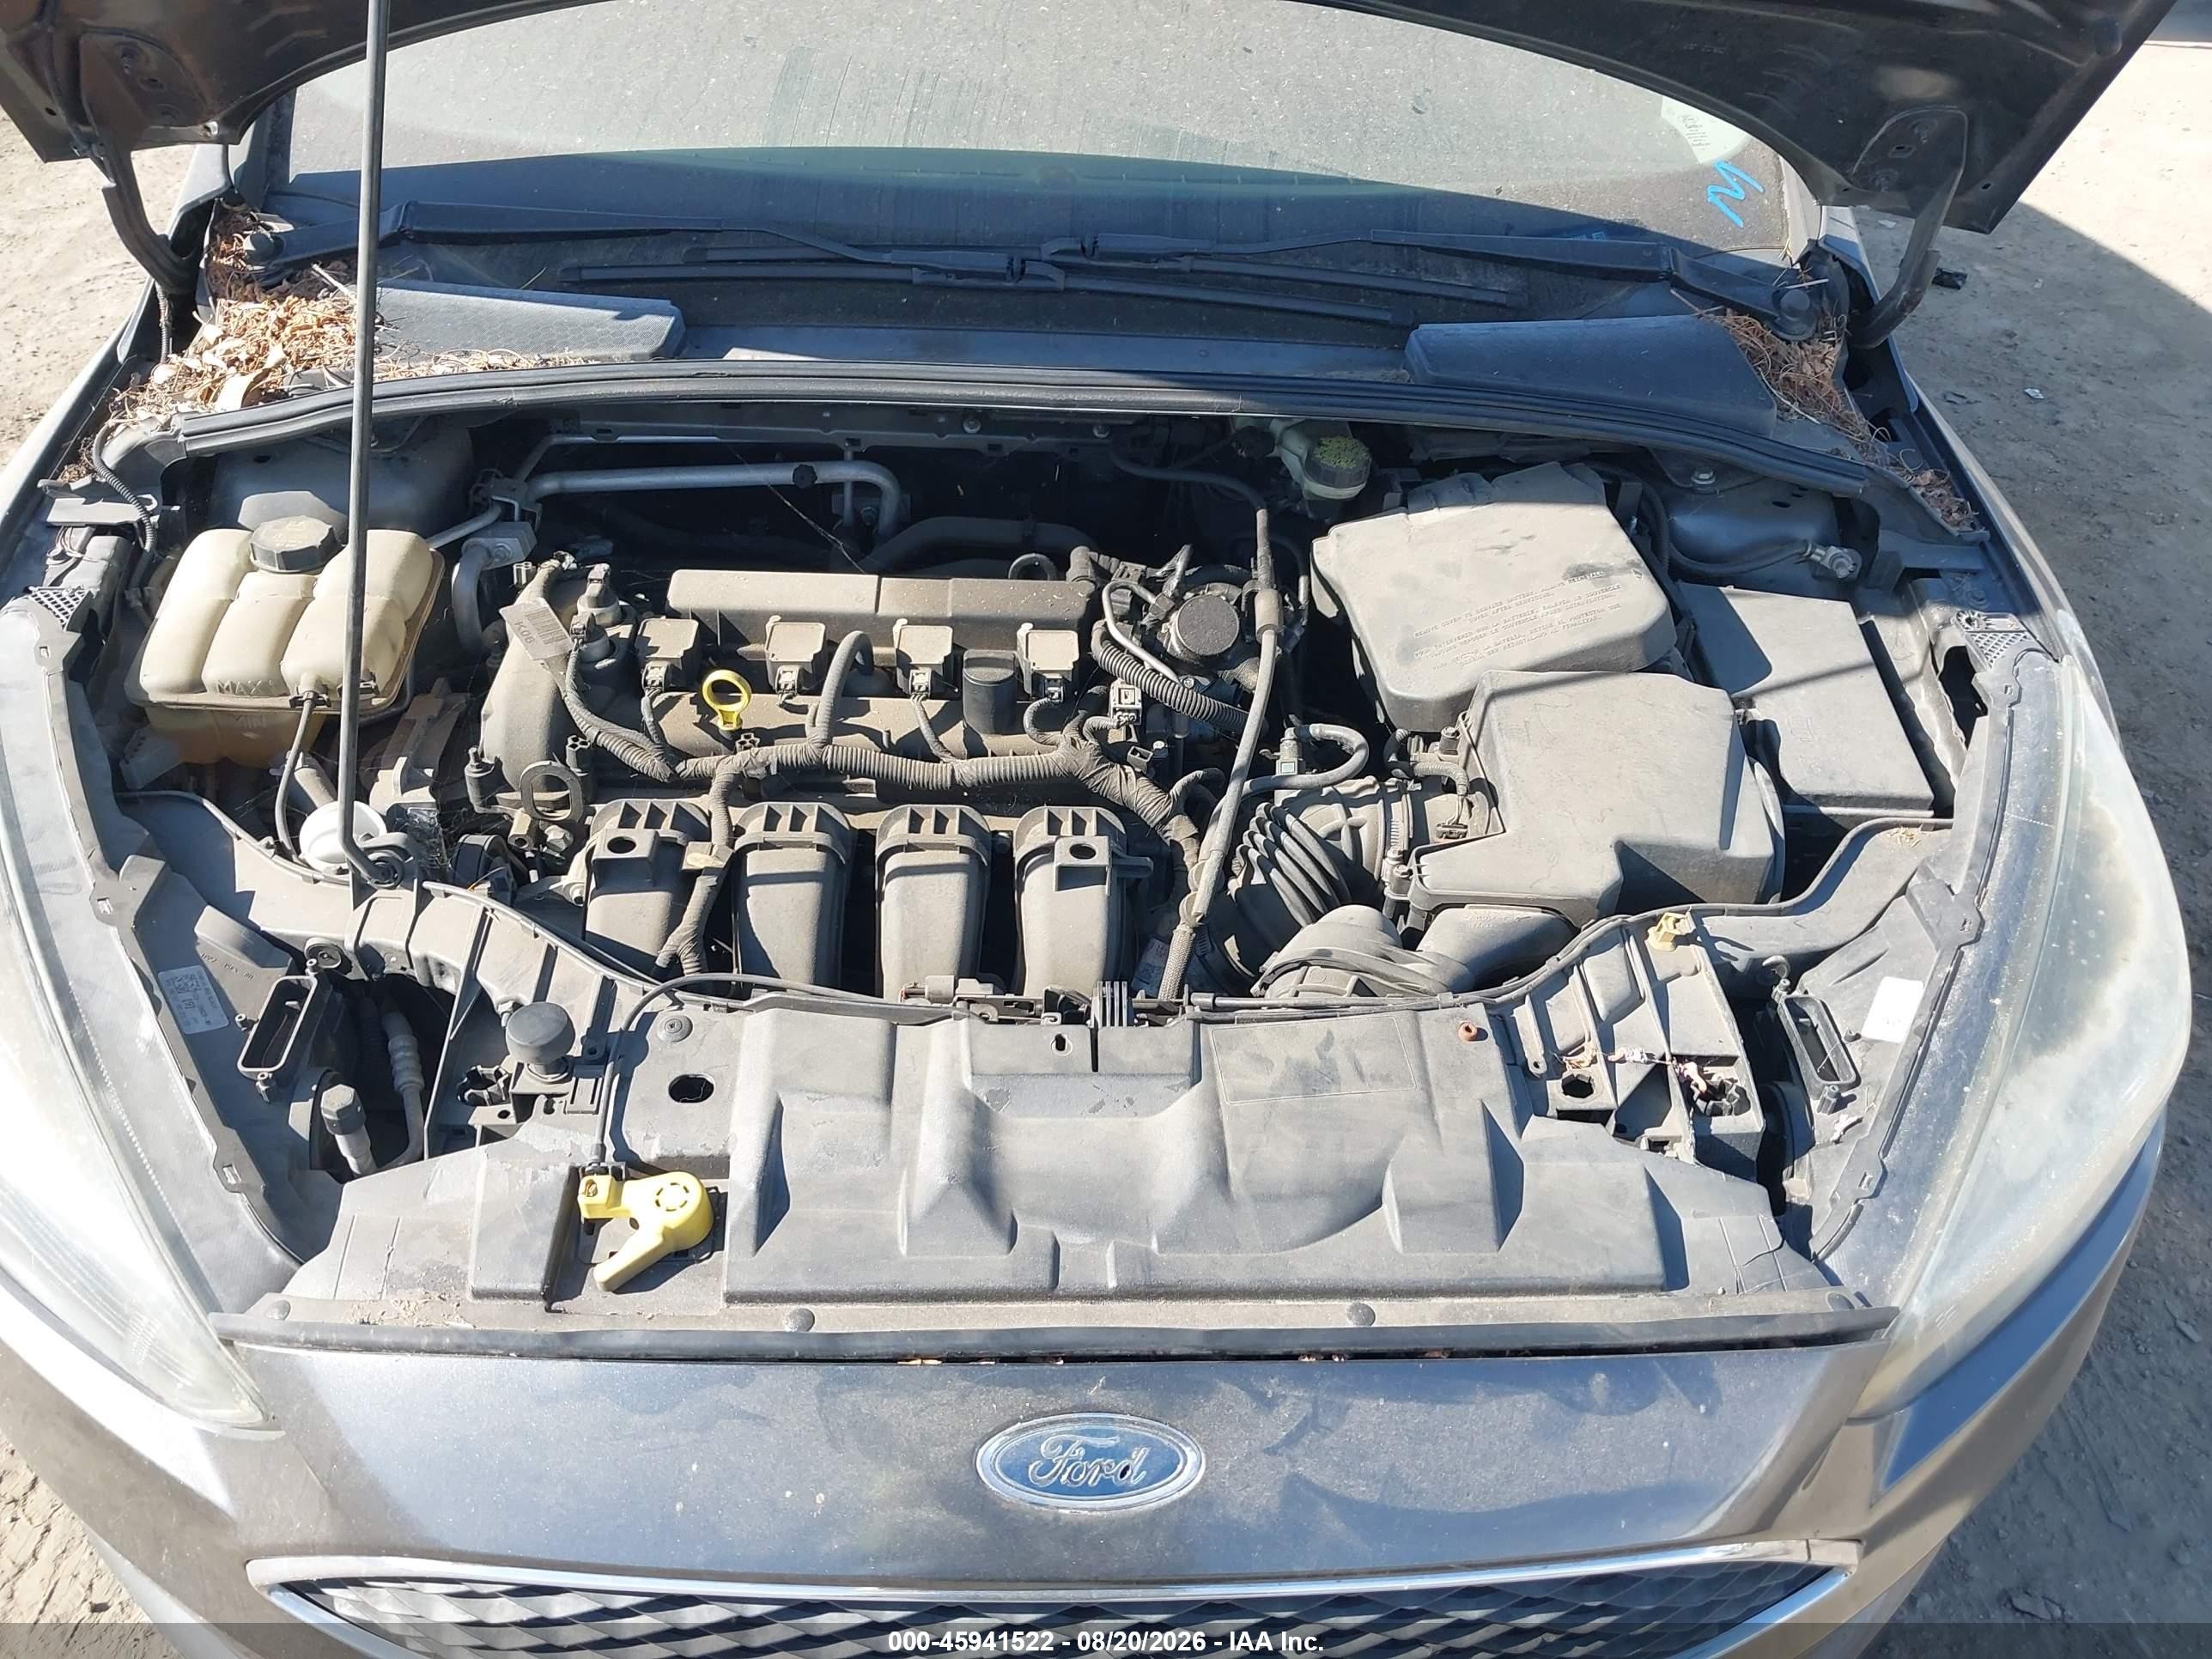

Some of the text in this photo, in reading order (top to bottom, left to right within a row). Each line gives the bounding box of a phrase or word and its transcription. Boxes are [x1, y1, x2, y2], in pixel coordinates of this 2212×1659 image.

[514, 620, 536, 645] K06
[216, 678, 262, 696] MAX
[1028, 1434, 1151, 1488] Ford
